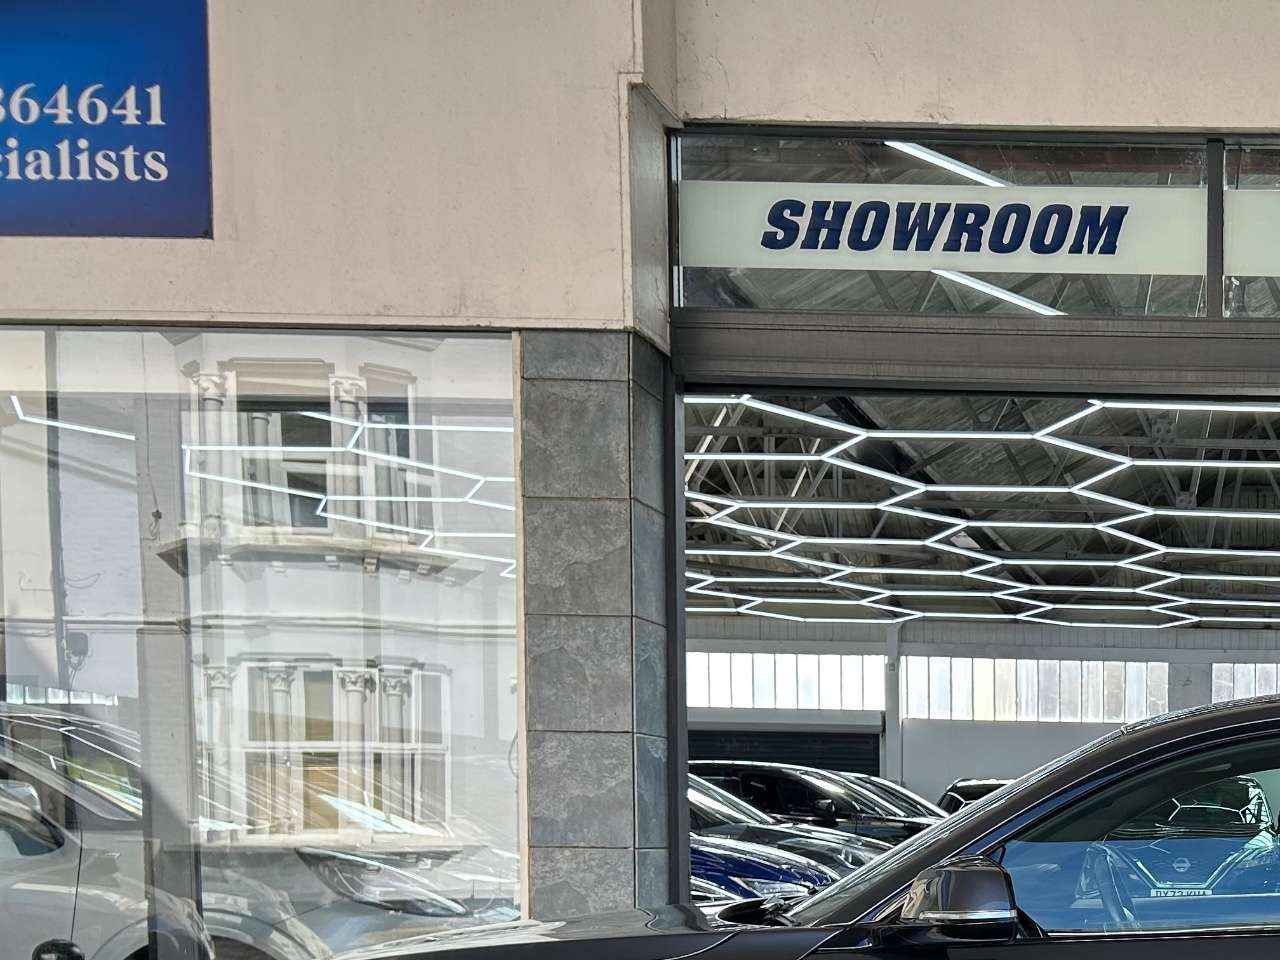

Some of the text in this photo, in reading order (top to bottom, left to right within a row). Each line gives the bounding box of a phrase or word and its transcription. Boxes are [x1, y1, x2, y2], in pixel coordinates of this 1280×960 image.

[0, 82, 166, 126] 64641
[0, 137, 169, 182] ialists
[760, 199, 1129, 255] SHOWROOM
